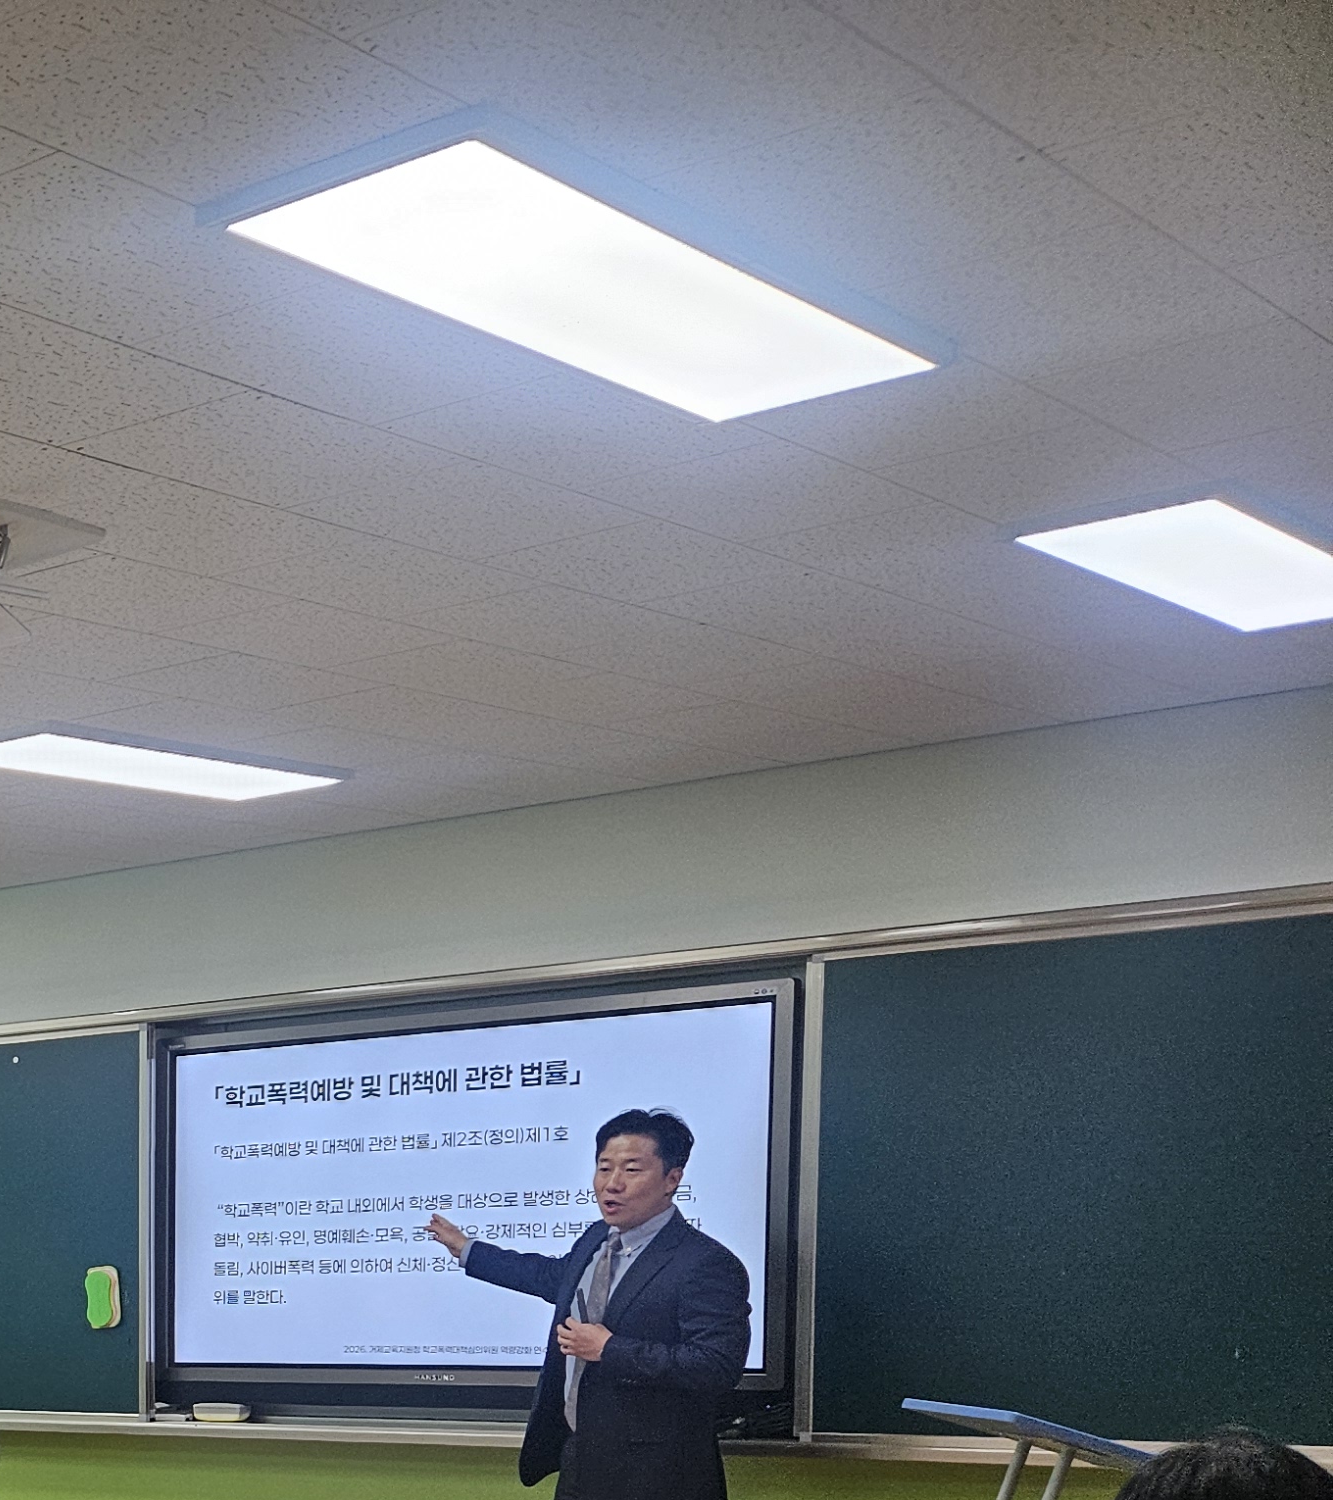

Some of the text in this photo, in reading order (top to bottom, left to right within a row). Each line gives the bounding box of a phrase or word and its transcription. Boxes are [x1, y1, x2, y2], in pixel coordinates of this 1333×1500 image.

[215, 1060, 581, 1108] 「학교폭력예방 및 대책에 관한 법률」
[214, 1141, 302, 1160] 「학교폭력예방
[305, 1139, 318, 1156] 및
[322, 1136, 365, 1155] 대책에
[368, 1134, 398, 1152] 관한
[315, 1199, 343, 1215] 학교
[347, 1196, 405, 1213] 내외에서
[409, 1193, 453, 1211] 학생을
[457, 1191, 519, 1209] 대상으로
[523, 1189, 571, 1207] 발생한
[213, 1231, 244, 1248] 협박,
[213, 1261, 244, 1278] 돌림,
[247, 1258, 315, 1276] 사이버폭력
[318, 1258, 346, 1274] 등에
[350, 1257, 393, 1274] 의하여
[213, 1289, 287, 1305] 위를 말한다.
